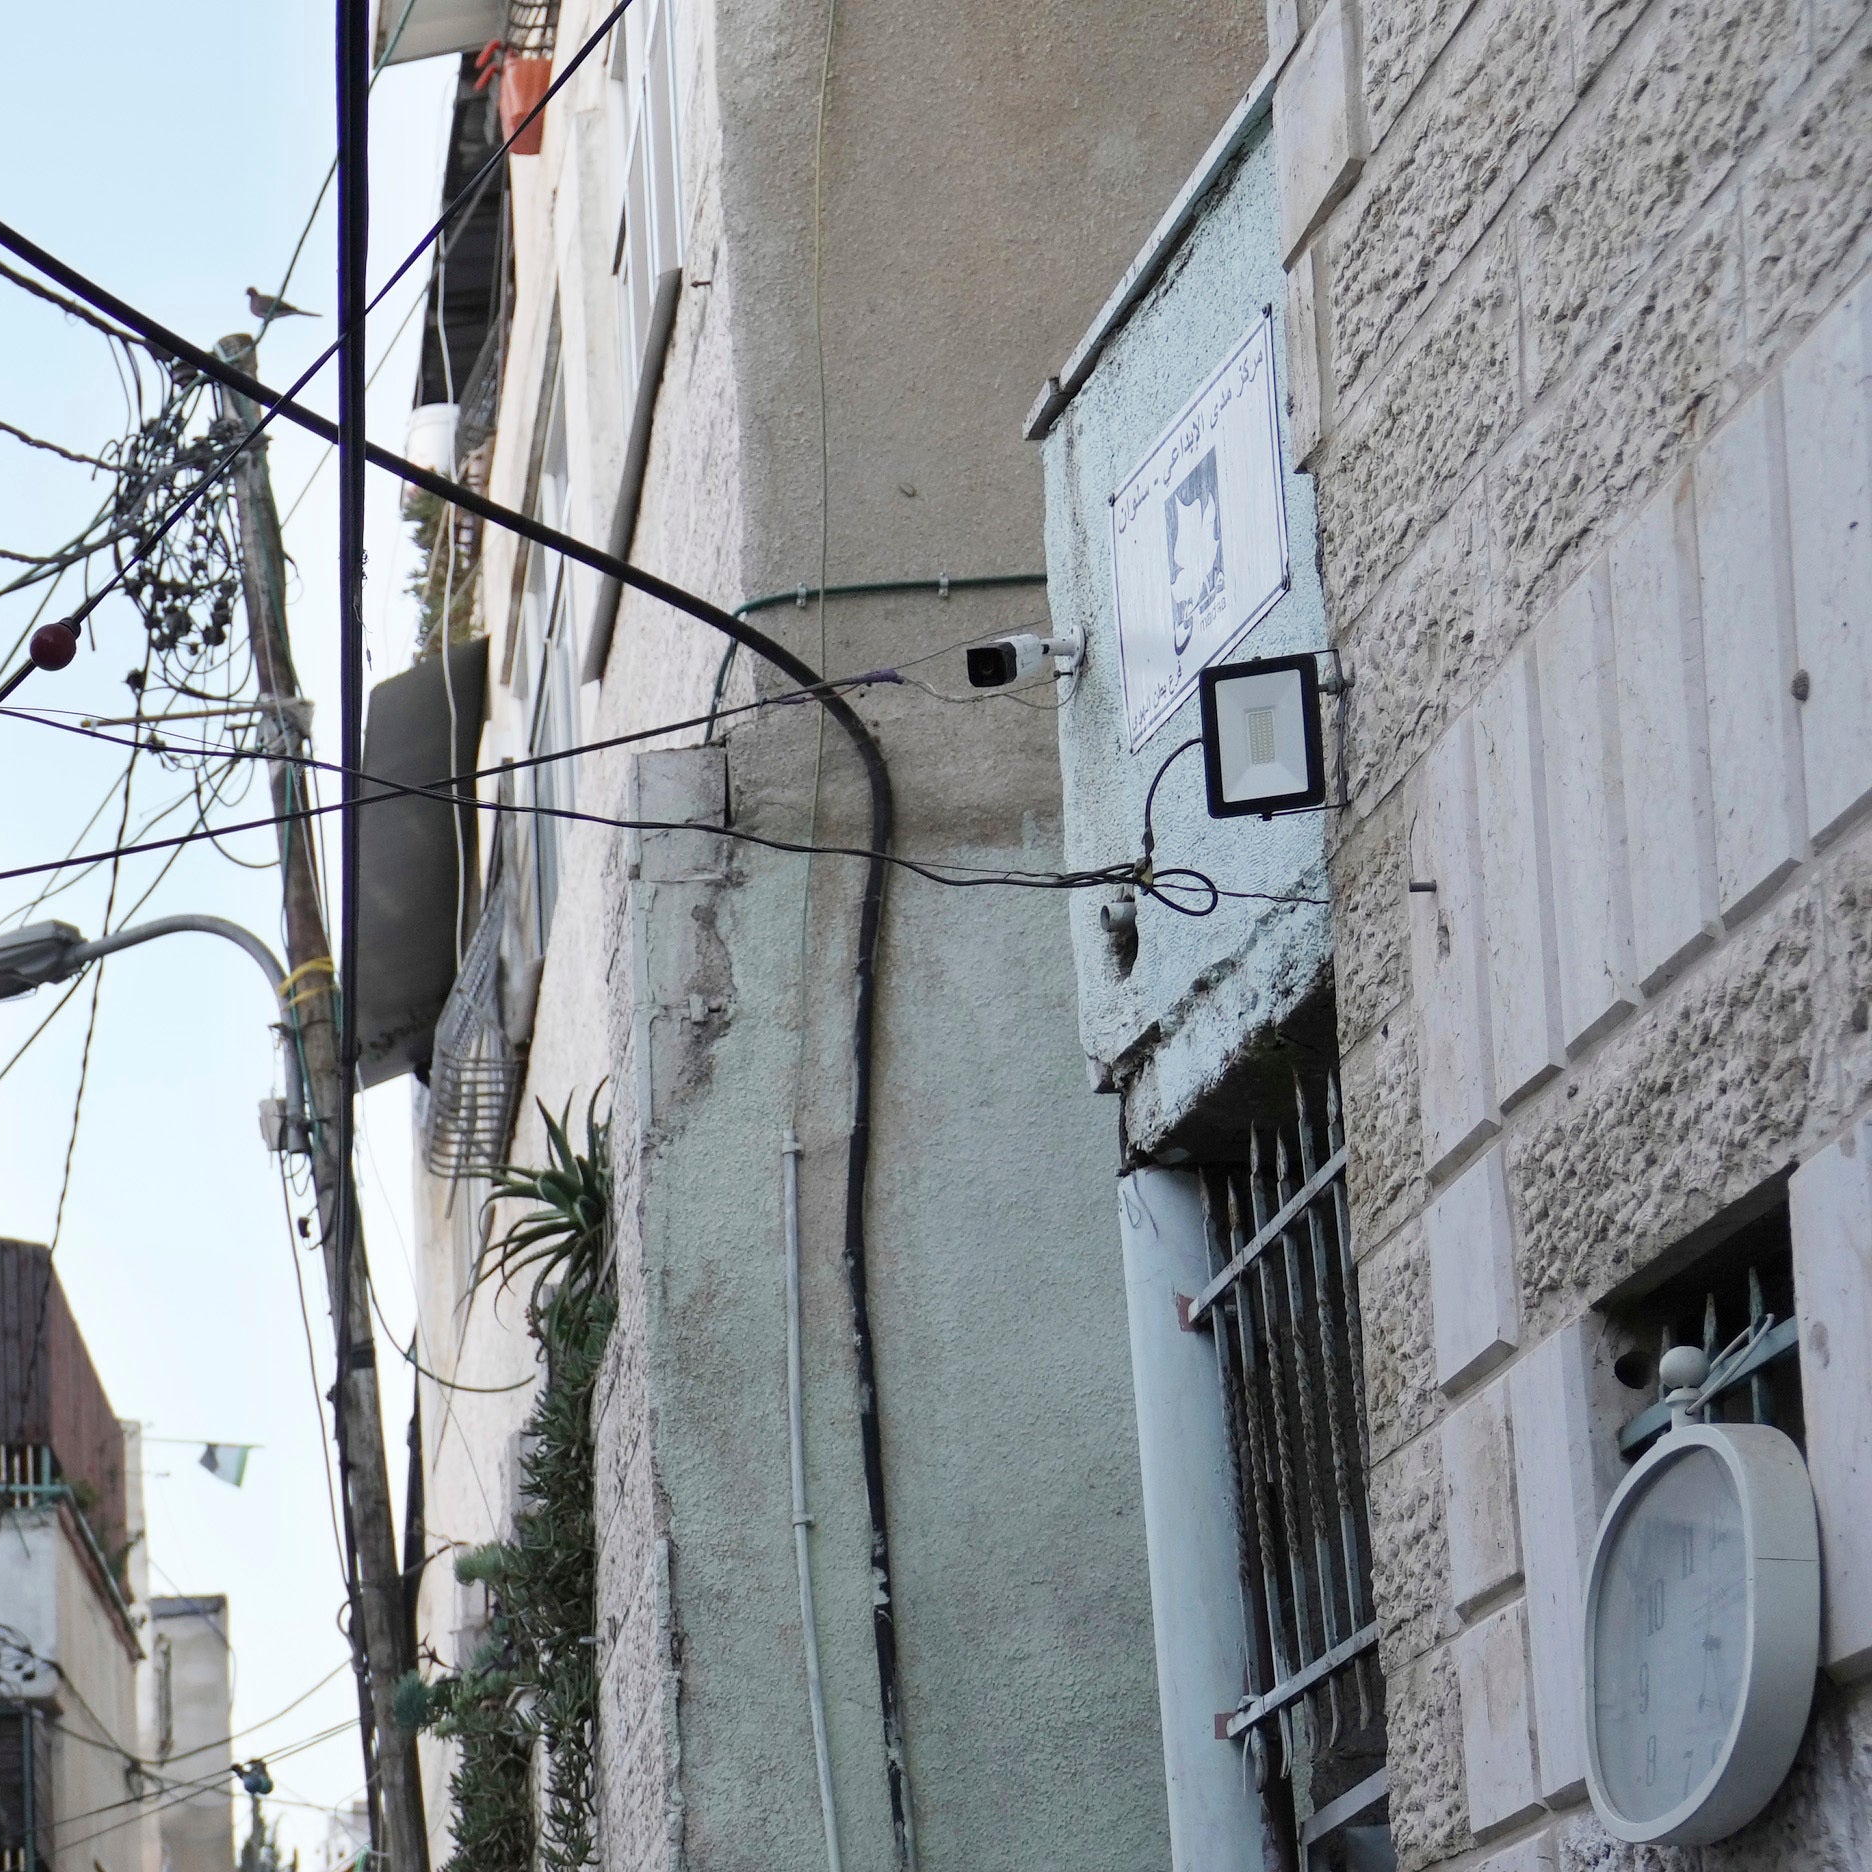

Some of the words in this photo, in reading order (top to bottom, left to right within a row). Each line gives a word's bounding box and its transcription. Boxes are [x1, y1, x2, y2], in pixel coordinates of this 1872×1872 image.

[1237, 351, 1263, 398] مركز
[1210, 387, 1232, 430] مدى
[1118, 483, 1150, 534] سلوان
[1647, 1578, 1665, 1637] 10
[1638, 1661, 1650, 1715] 9
[1646, 1734, 1657, 1787] 8
